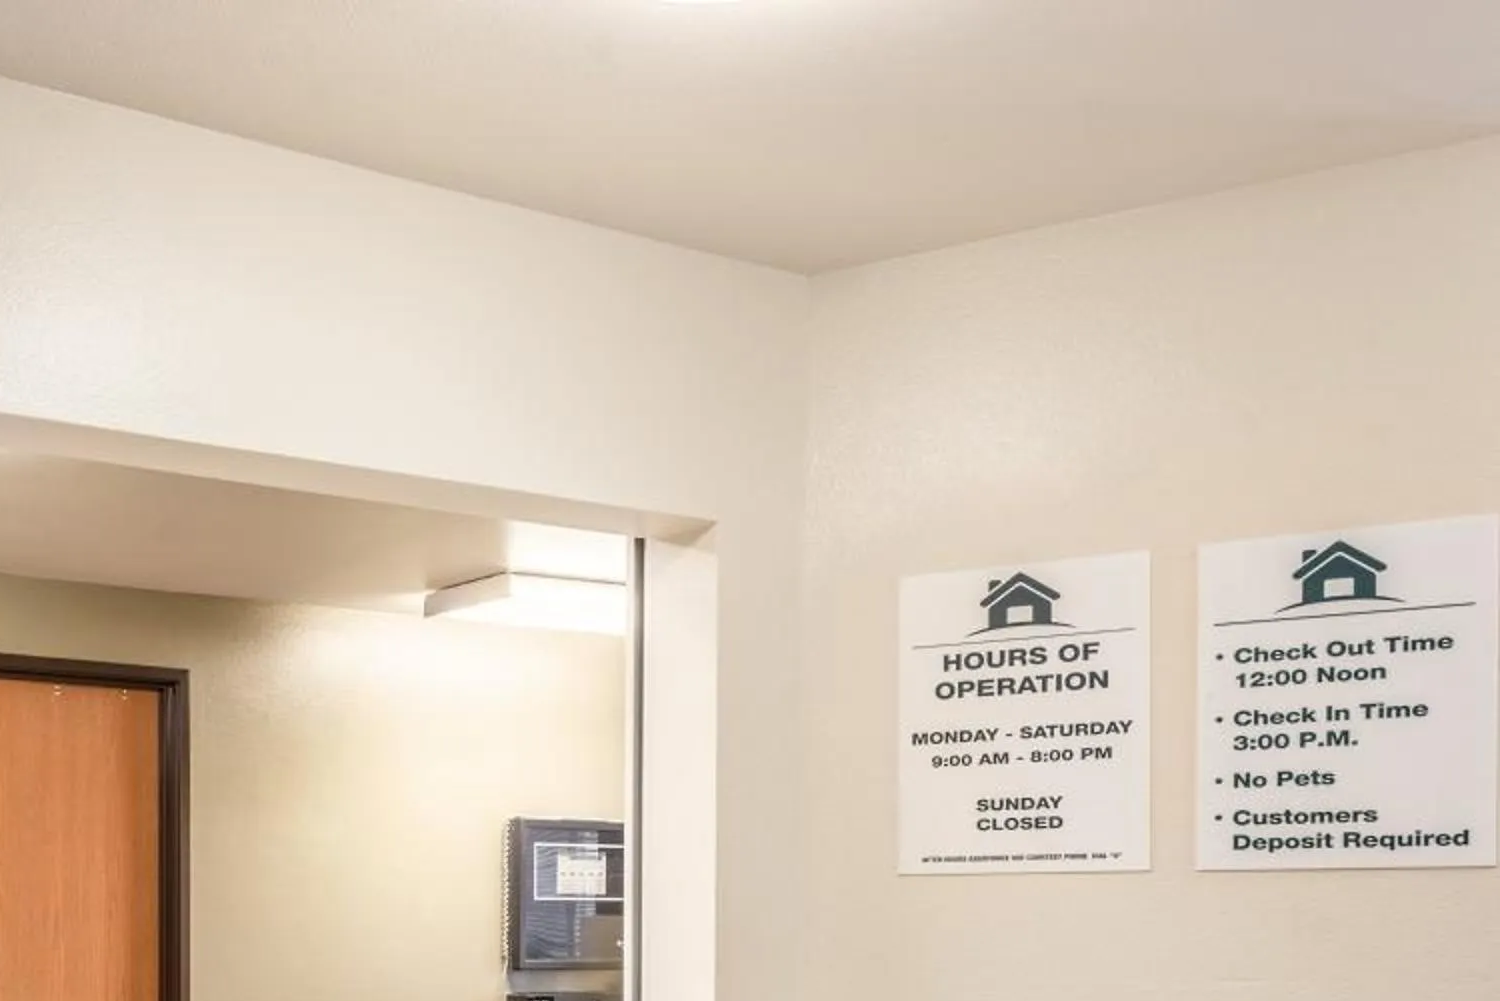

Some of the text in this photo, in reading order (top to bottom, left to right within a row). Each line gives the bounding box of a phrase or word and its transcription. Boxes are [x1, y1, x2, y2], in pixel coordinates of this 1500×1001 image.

[943, 641, 1100, 673] HOURS OF
[1233, 635, 1454, 663] Check Out Time
[935, 669, 1110, 700] OPERATION
[1235, 666, 1387, 689] 12:00 Noon
[1233, 702, 1429, 727] Check In Time
[911, 727, 999, 746] MONDAY
[1019, 719, 1133, 739] SATURDAY
[1233, 729, 1359, 752] 3:00 P.M.
[931, 753, 973, 769] 9:00
[978, 751, 1010, 765] AM
[1030, 748, 1074, 763] 8:00
[1080, 746, 1113, 761] PM
[1233, 770, 1336, 789] No Pets
[976, 795, 1063, 812] SUNDAY
[976, 815, 1064, 832] CLOSED
[1232, 809, 1379, 827] Customers
[1233, 829, 1470, 854] Deposit Required
